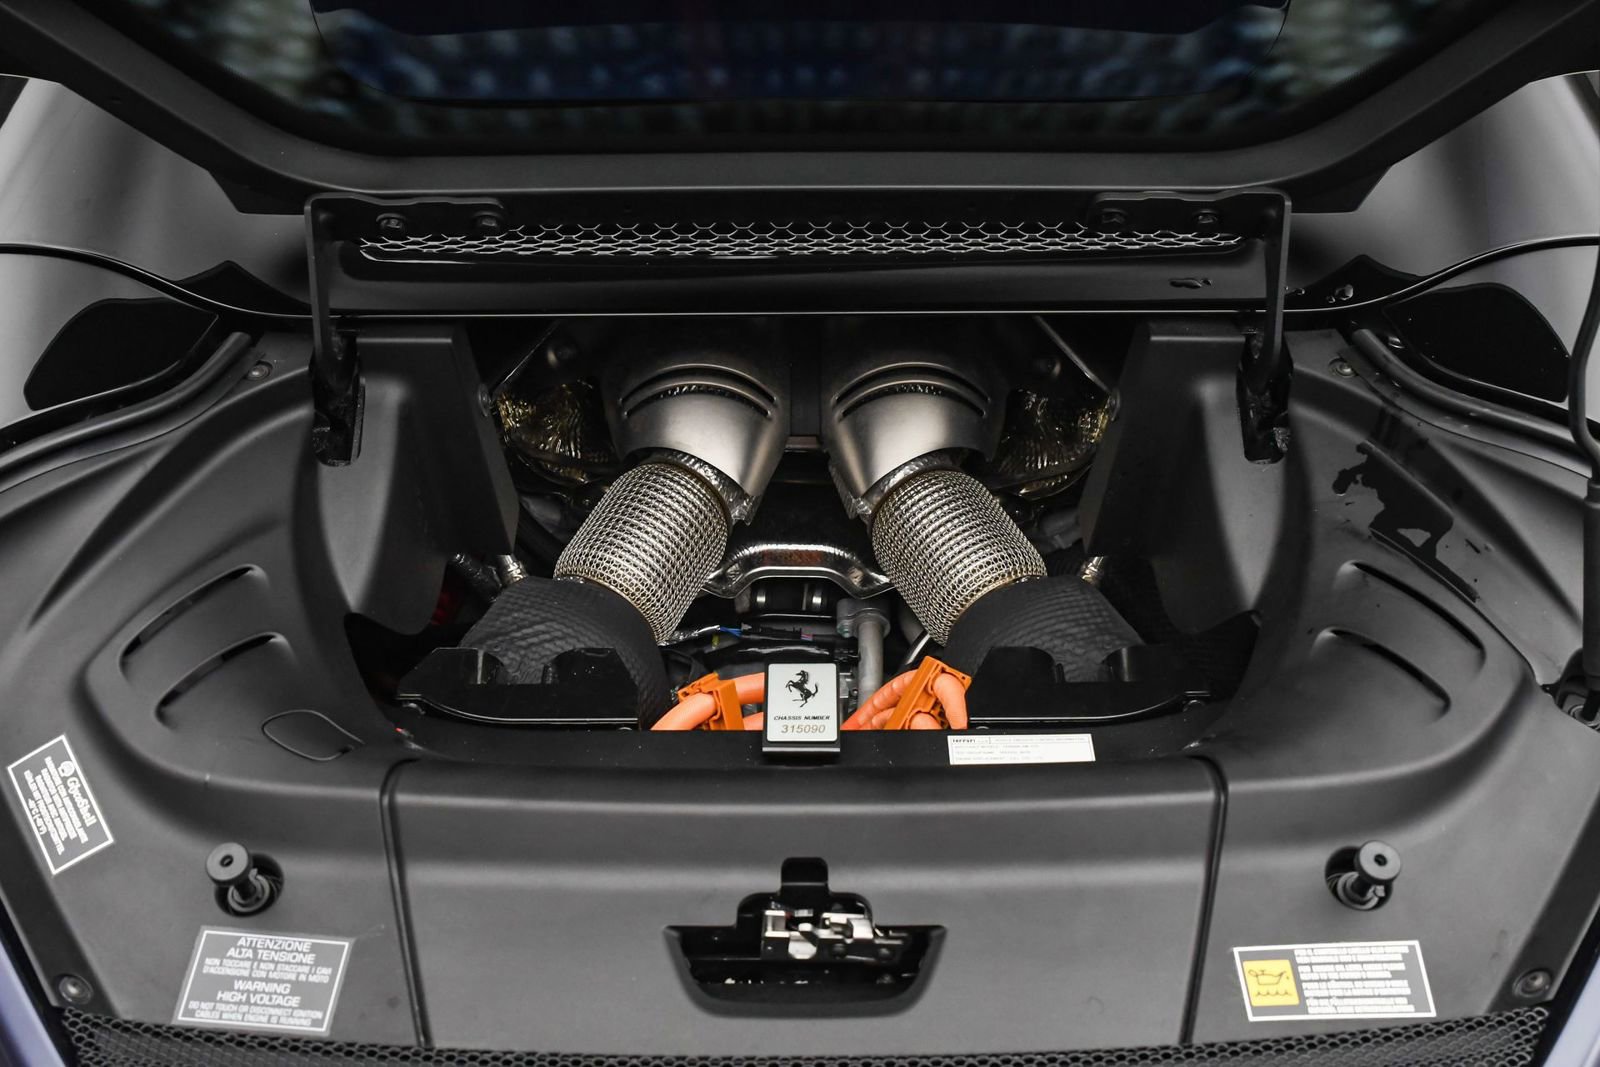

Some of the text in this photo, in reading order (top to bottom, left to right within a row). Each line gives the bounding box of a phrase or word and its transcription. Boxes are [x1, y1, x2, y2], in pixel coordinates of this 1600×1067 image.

[781, 724, 826, 733] 315090
[67, 777, 97, 827] GlycoShell
[237, 936, 312, 952] ATTENZIONE
[226, 948, 316, 965] ALTA TENSIONE
[205, 958, 220, 966] NON
[260, 962, 275, 970] NON
[252, 970, 266, 978] CON
[308, 974, 329, 983] MOTO
[234, 980, 291, 994] WARNING
[200, 1002, 214, 1010] NOT
[217, 991, 301, 1007] HIGH VOLTAGE
